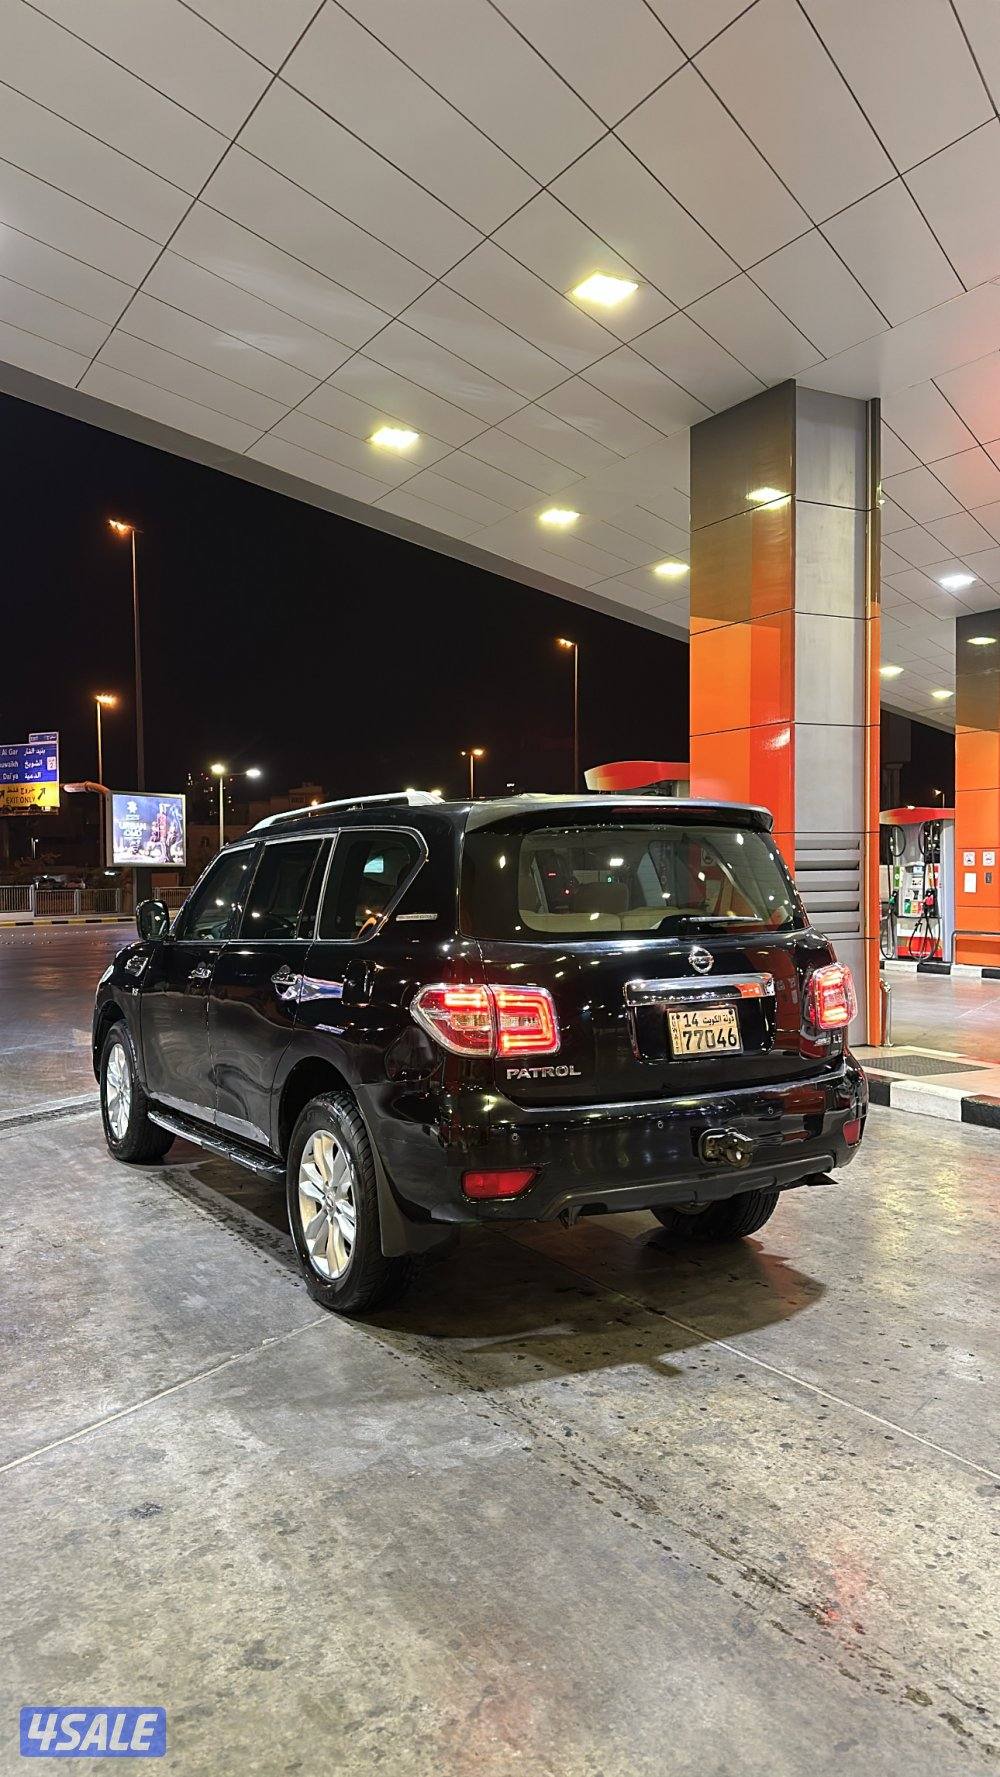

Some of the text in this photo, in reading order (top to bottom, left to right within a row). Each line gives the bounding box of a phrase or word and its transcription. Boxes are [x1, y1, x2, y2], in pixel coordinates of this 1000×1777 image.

[9, 748, 18, 756] Gar
[20, 796, 35, 804] ONLY
[683, 1013, 699, 1028] 14
[702, 1014, 735, 1026] دولة الكويت
[682, 1027, 737, 1051] 77046
[506, 1065, 582, 1080] PATROL
